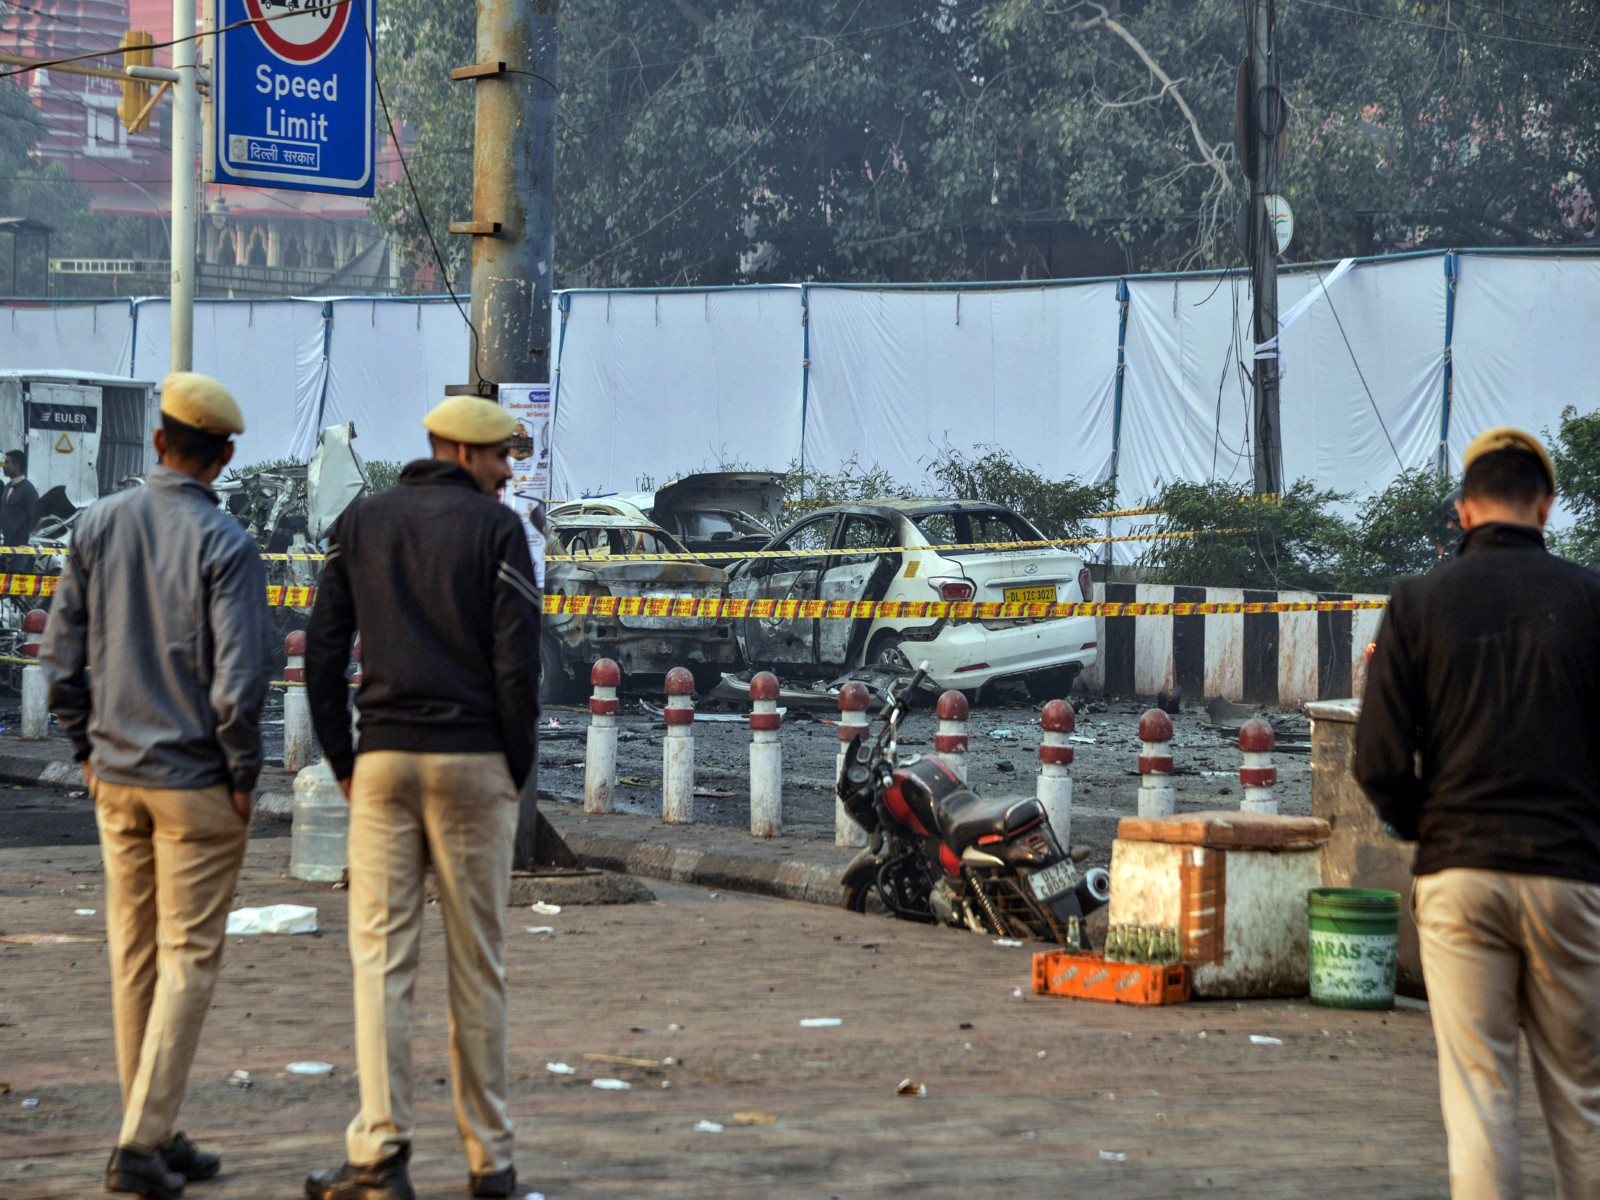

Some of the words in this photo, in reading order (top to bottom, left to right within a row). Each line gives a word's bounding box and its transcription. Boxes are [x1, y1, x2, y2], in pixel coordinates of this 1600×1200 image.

[256, 64, 337, 101] Speed
[266, 107, 328, 141] Limit
[250, 142, 278, 161] दिल्ली
[282, 150, 316, 165] सरकार
[54, 412, 87, 424] EULER
[1010, 592, 1020, 602] DL
[1022, 591, 1036, 601] 1ZC
[1037, 588, 1055, 600] 3027
